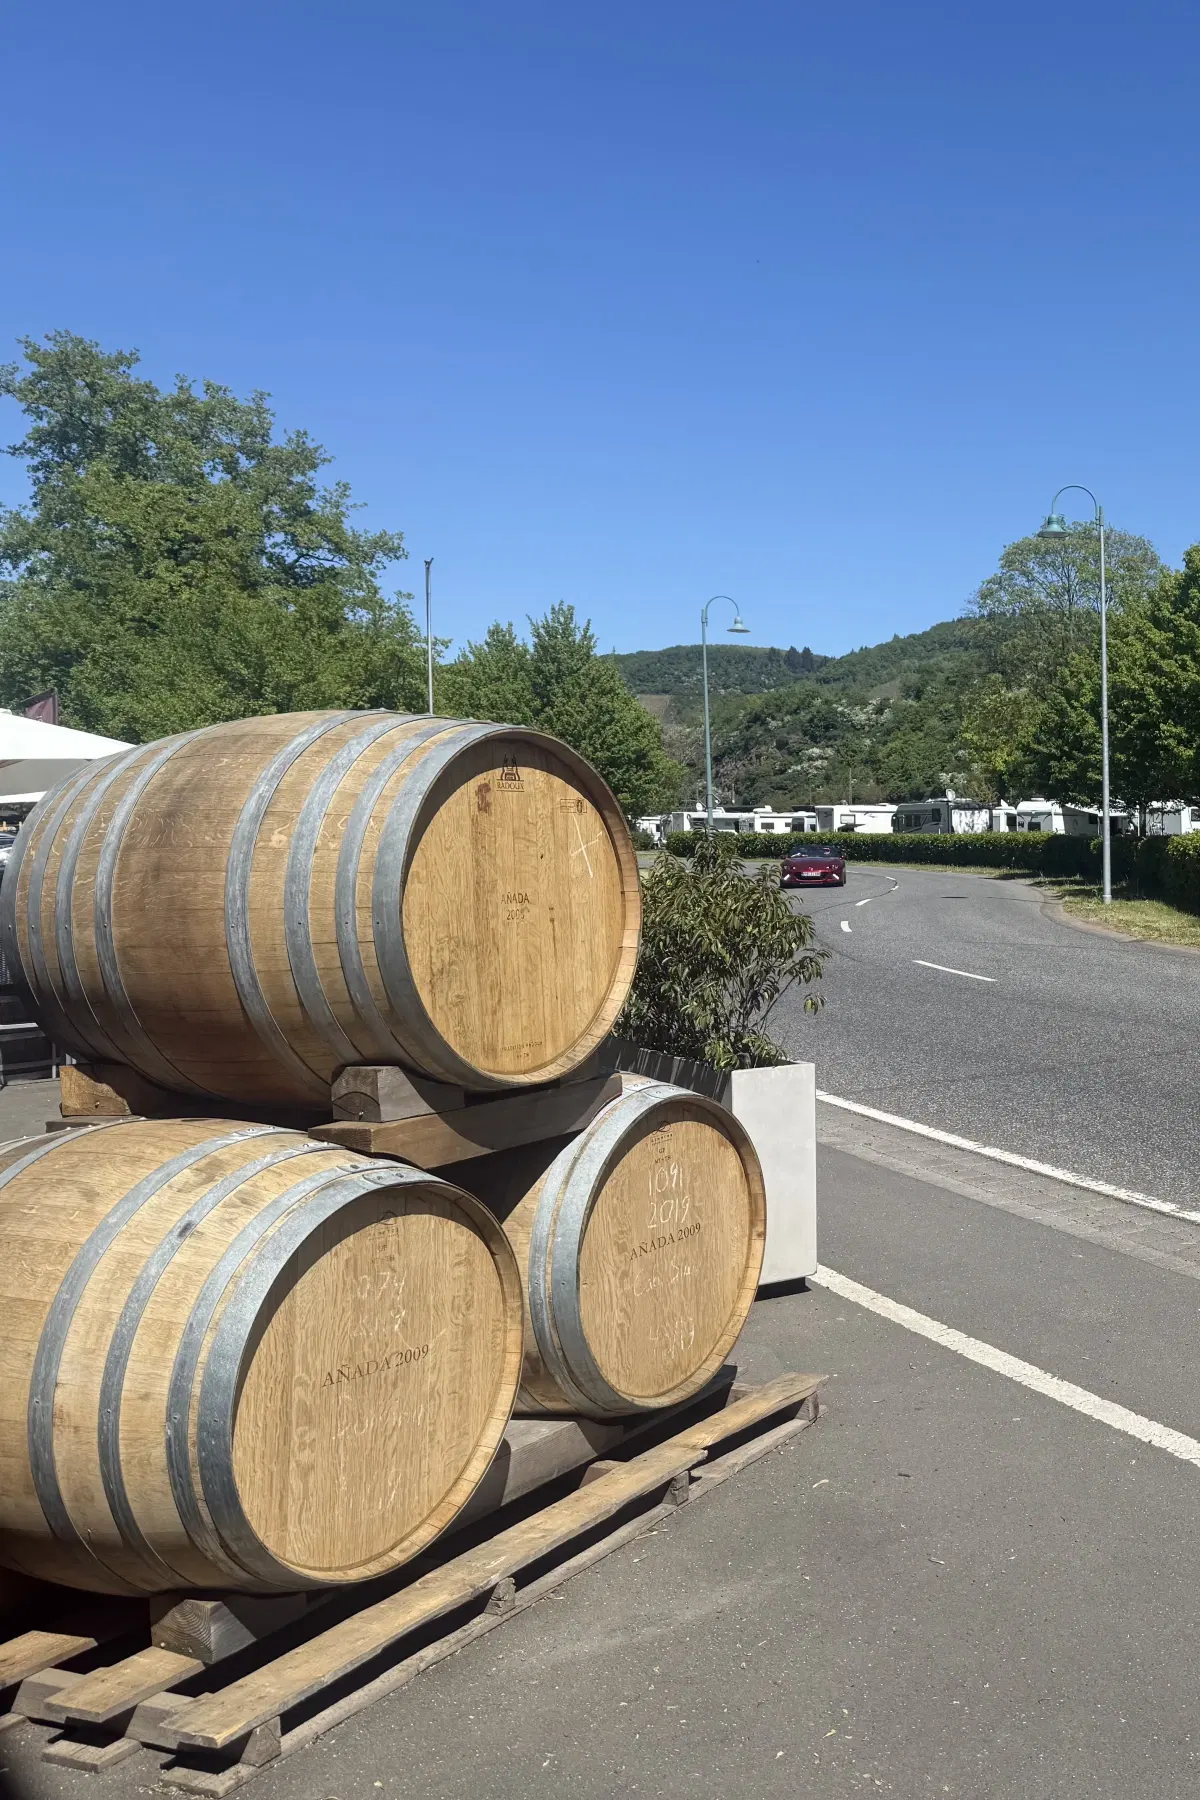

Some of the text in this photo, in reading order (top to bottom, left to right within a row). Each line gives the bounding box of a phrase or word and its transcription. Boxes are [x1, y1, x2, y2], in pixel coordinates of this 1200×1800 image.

[497, 781, 524, 790] RADOUX
[501, 892, 530, 904] AÑADA
[649, 1162, 683, 1196] 1091
[648, 1195, 691, 1228] 2019
[630, 1222, 701, 1260] AÑADA 2009
[322, 1344, 429, 1387] AÑADA 2009
